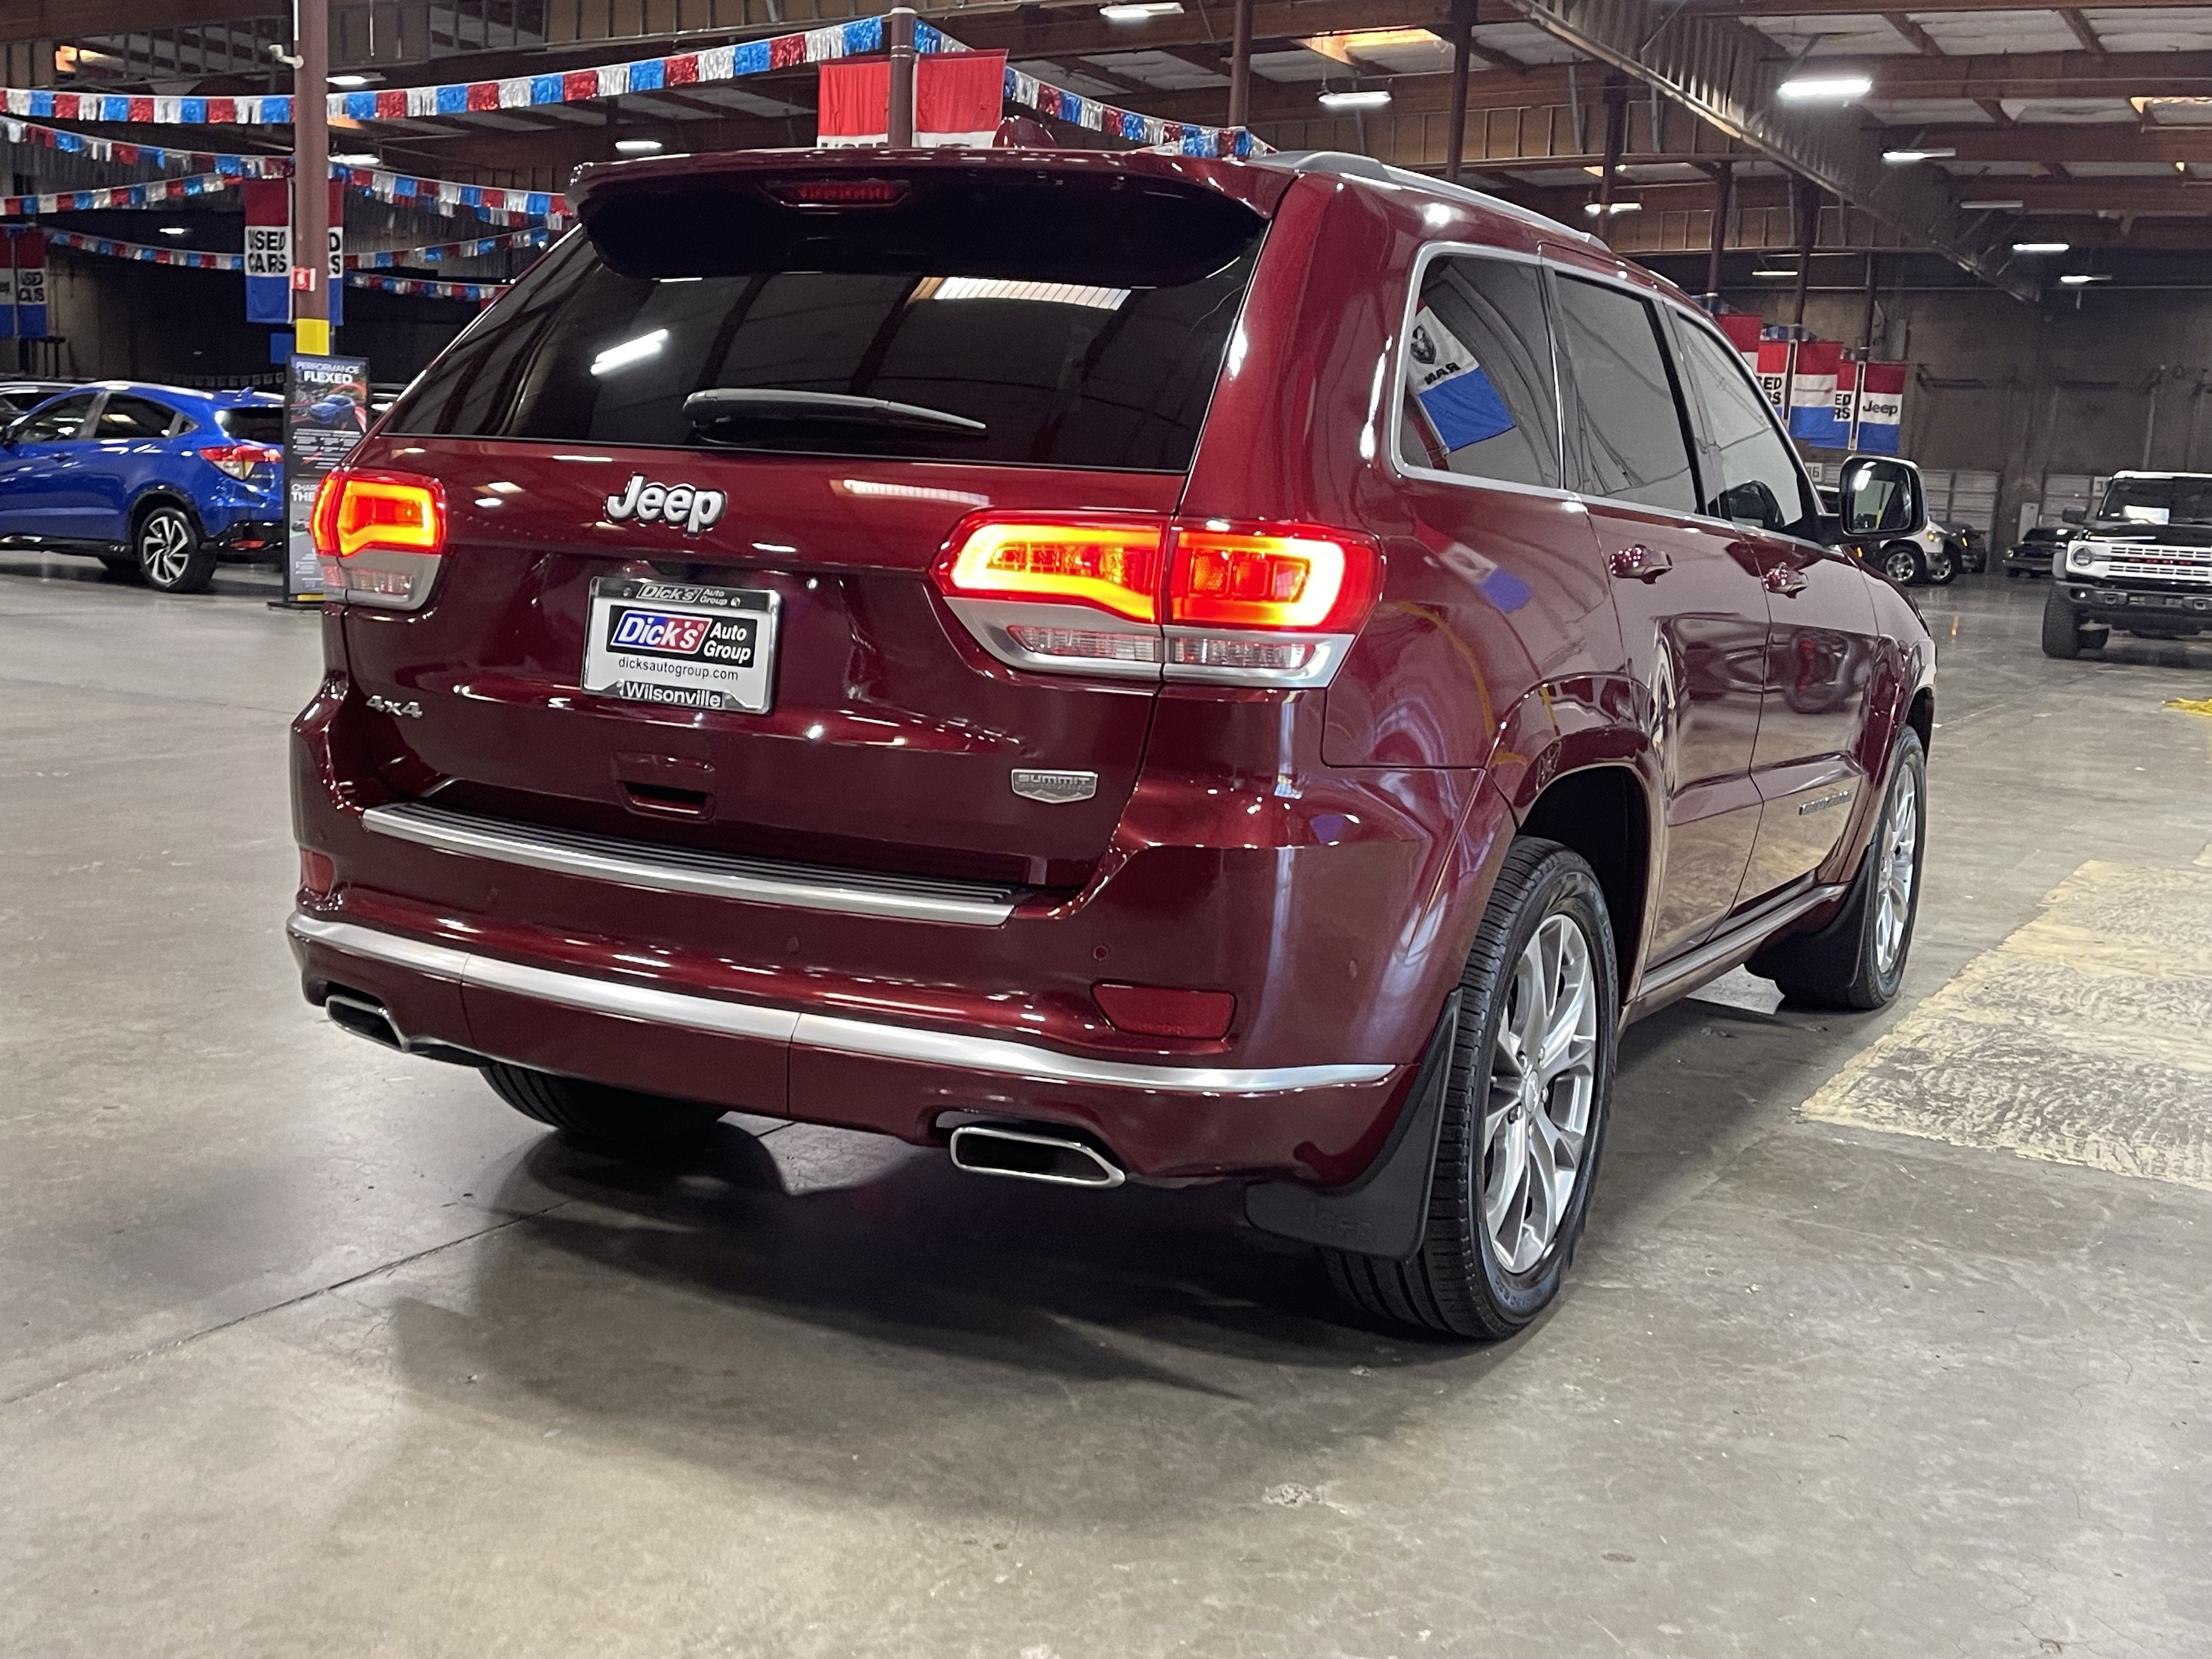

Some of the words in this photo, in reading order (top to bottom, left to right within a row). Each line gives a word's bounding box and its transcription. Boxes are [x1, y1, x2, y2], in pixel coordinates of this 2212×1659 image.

[303, 370, 353, 384] FLEXED
[1863, 400, 1899, 417] Jeep
[606, 475, 726, 534] Jeep
[699, 595, 728, 606] Group
[702, 589, 725, 597] Auto
[618, 616, 700, 650] Dick's
[710, 622, 748, 641] Auto
[703, 640, 751, 664] Group
[618, 656, 739, 681] dicksautogroup.com
[625, 681, 722, 708] Wilsonville
